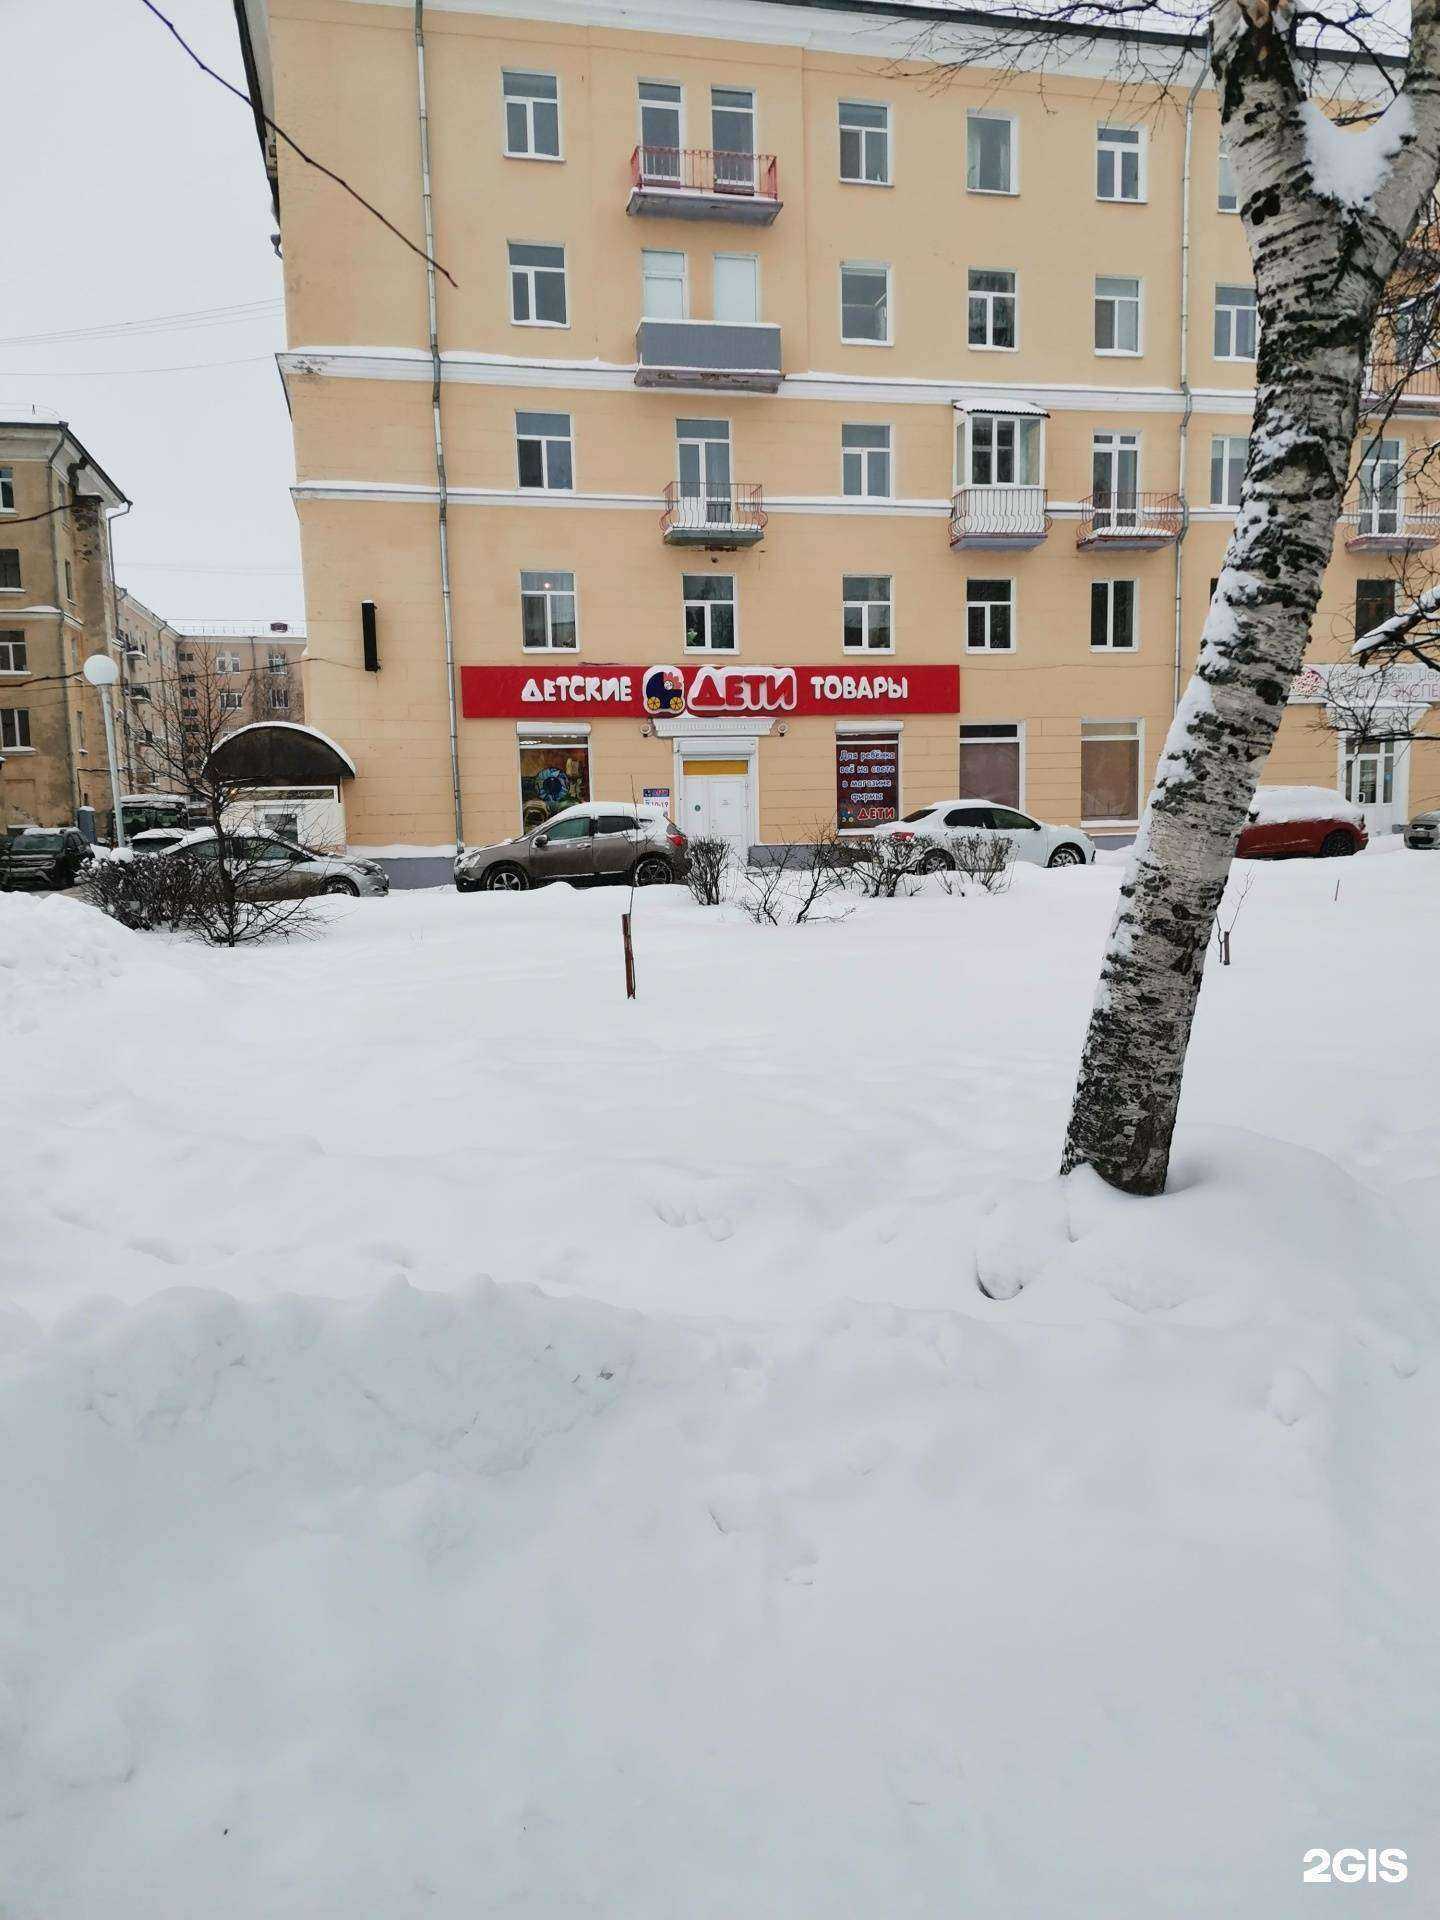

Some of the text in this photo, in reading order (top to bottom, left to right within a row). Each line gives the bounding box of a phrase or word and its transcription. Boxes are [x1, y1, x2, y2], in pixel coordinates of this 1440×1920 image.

[521, 674, 908, 708] ДЕТСКИЕ ДЕТИ ТОВАРЫ
[840, 750, 895, 762] Для ребёнка
[851, 793, 883, 803] фирмы
[857, 807, 895, 820] ДЕТИ
